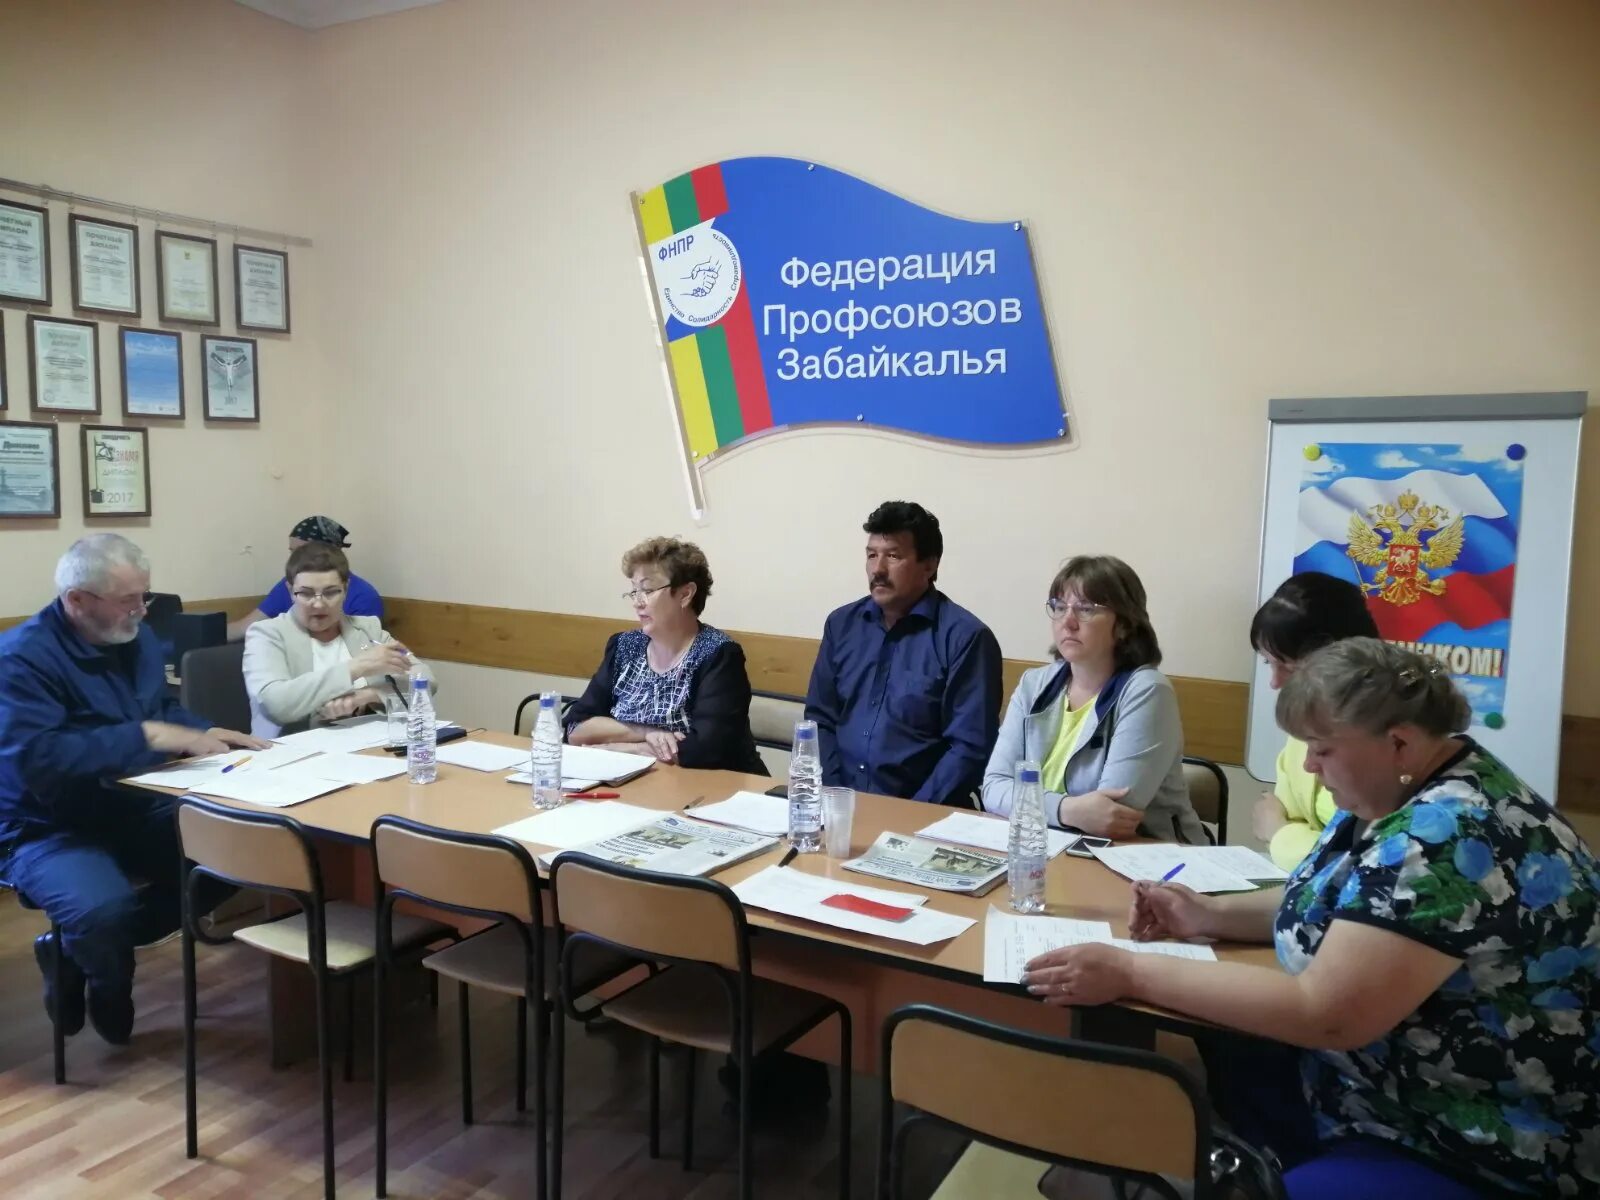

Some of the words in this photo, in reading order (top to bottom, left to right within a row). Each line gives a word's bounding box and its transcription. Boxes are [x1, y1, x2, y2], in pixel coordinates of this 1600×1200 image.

[658, 235, 695, 260] ФНПР
[780, 249, 997, 291] Федерация
[664, 287, 685, 319] Единство
[688, 296, 733, 323] Солидарность
[763, 298, 1022, 343] Профсоюзов
[776, 344, 1007, 380] Забайкалья
[107, 492, 134, 504] 2017
